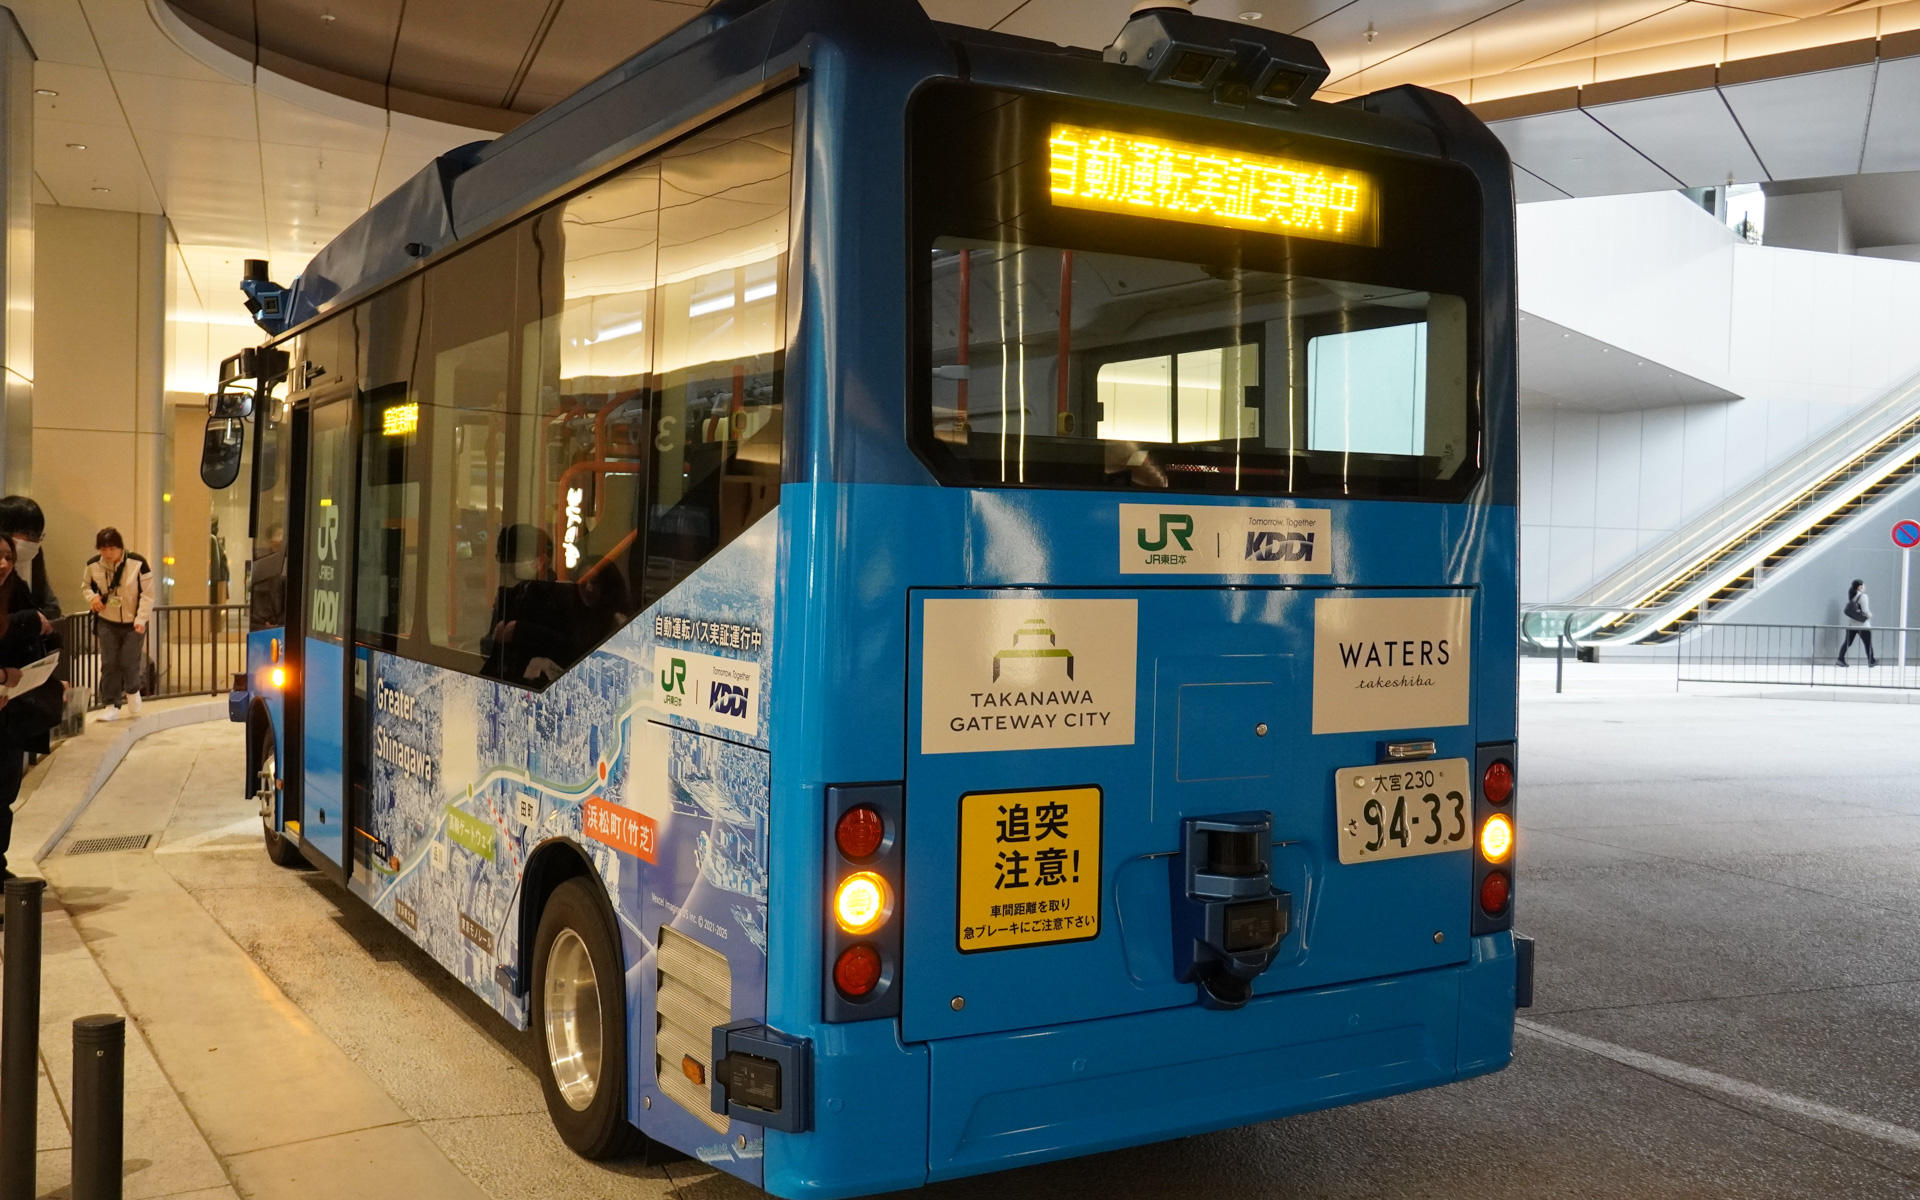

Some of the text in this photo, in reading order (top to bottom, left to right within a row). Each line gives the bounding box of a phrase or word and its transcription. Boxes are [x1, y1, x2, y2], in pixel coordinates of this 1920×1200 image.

[1049, 129, 1359, 233] 自動運転実証実験中
[1137, 513, 1194, 551] JR
[1286, 519, 1316, 528] Together
[1145, 554, 1187, 565] JR東日本
[1244, 531, 1315, 562] KDDI
[312, 589, 339, 634] KDDI
[655, 616, 762, 651] 自動運転バス実証運行中
[1339, 640, 1450, 668] WATERS
[661, 657, 687, 695] JR
[732, 669, 751, 682] Together
[1355, 675, 1436, 689] takeshiba
[377, 677, 415, 721] Greater
[709, 681, 749, 719] KDDI
[970, 690, 1094, 708] TAKANAWA
[950, 712, 1111, 732] GATEWAY CITY
[377, 724, 432, 781] Shinagawa
[520, 800, 534, 822] 田町
[996, 801, 1069, 844] 追突
[1363, 791, 1466, 852] 94-33
[994, 847, 1080, 890] 注意!
[990, 898, 1071, 918] 車間距離を取り
[704, 918, 728, 940] 2021-2025
[963, 915, 1096, 940] 急ブレーキにご注意下さい
